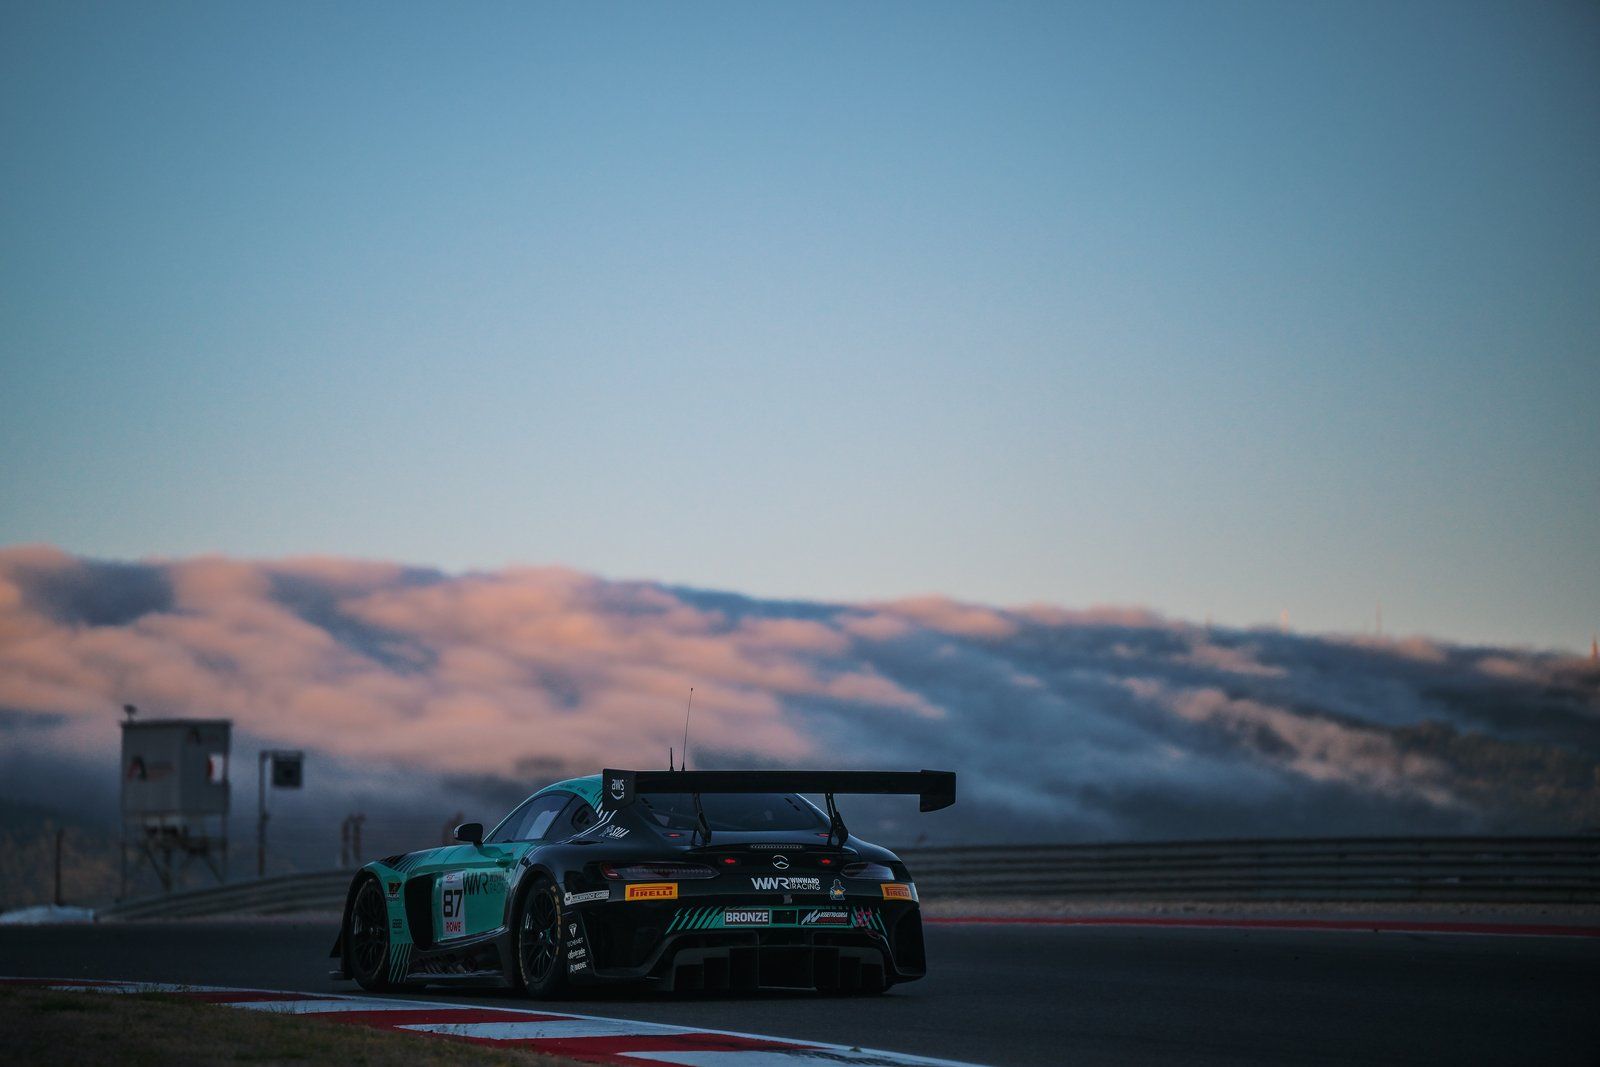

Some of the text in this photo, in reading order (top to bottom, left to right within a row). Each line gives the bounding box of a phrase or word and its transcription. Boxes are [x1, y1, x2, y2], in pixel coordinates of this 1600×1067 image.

[612, 779, 624, 790] aws
[629, 886, 673, 897] PIRELLI
[443, 889, 463, 917] 87
[725, 911, 769, 923] BRONZE
[446, 921, 461, 932] ROWE
